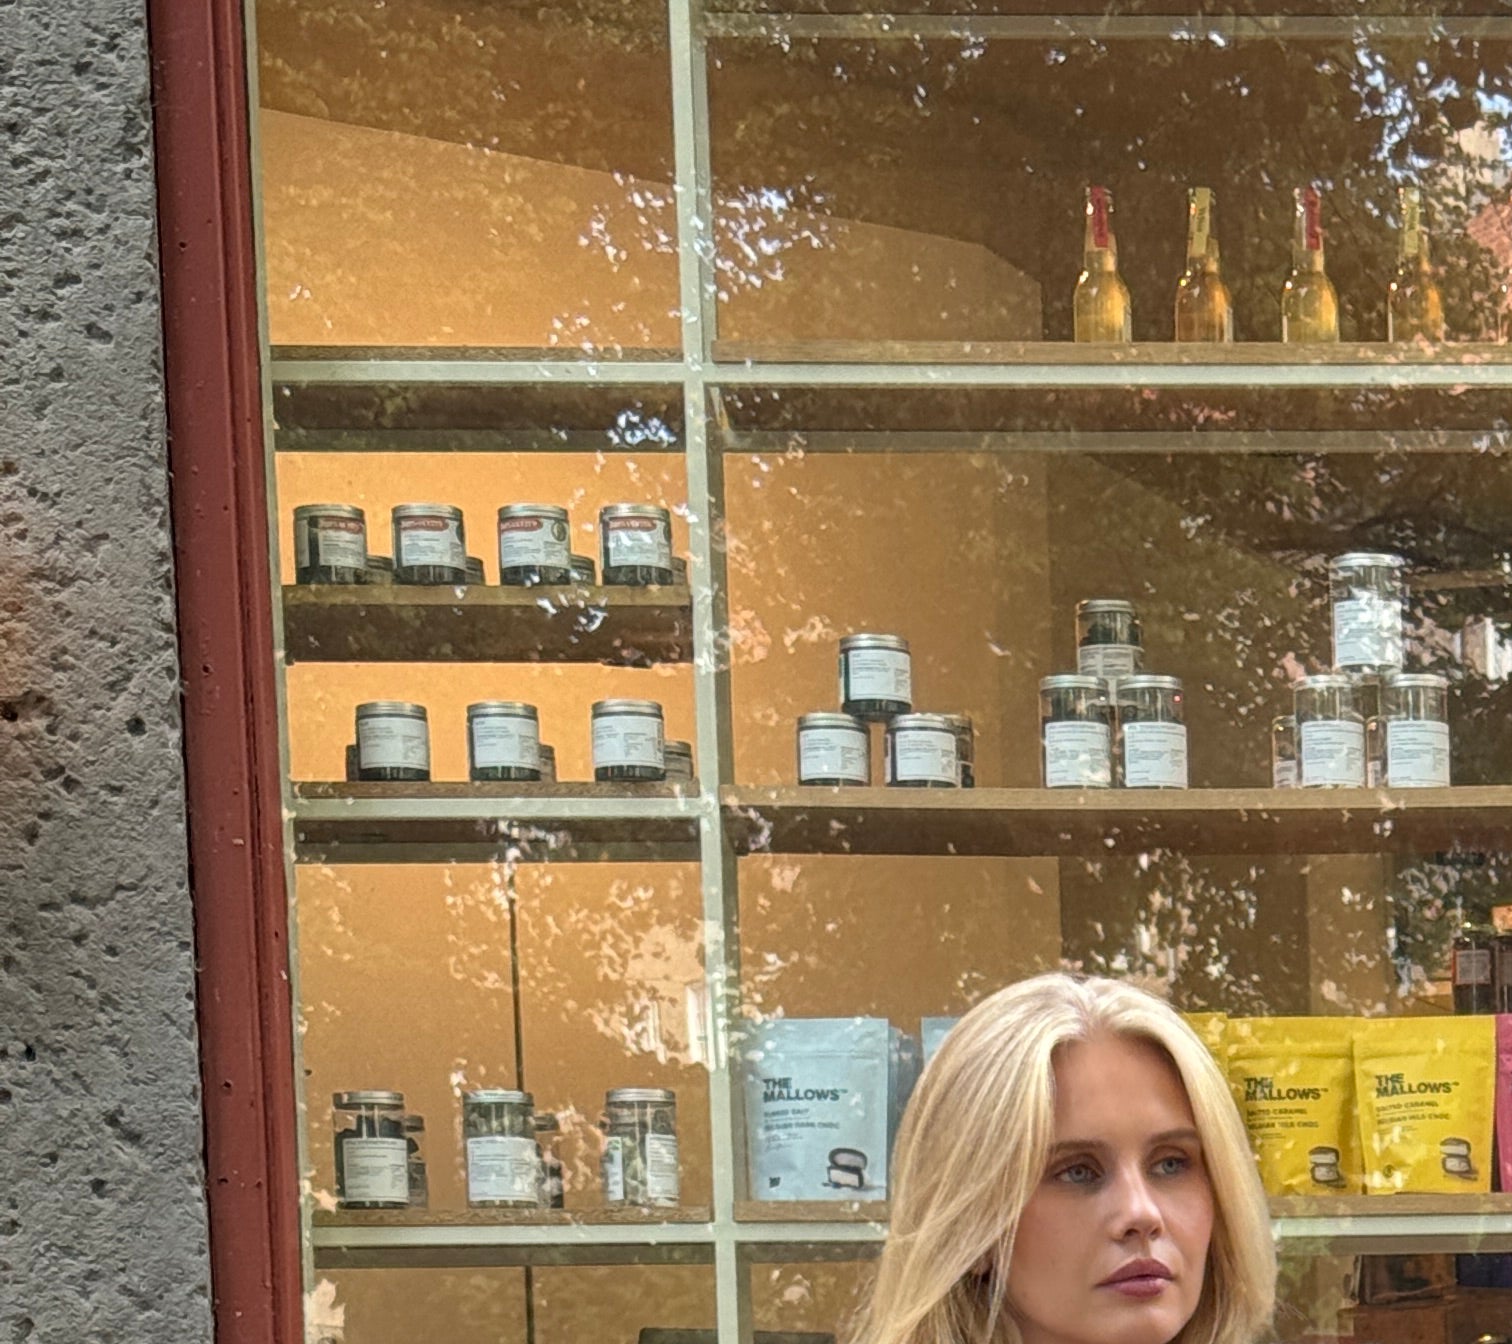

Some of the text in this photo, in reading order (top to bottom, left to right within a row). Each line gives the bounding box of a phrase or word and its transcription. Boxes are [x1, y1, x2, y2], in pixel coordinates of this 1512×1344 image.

[762, 1077, 792, 1090] THE
[1244, 1076, 1273, 1090] THE
[1375, 1073, 1405, 1087] THE
